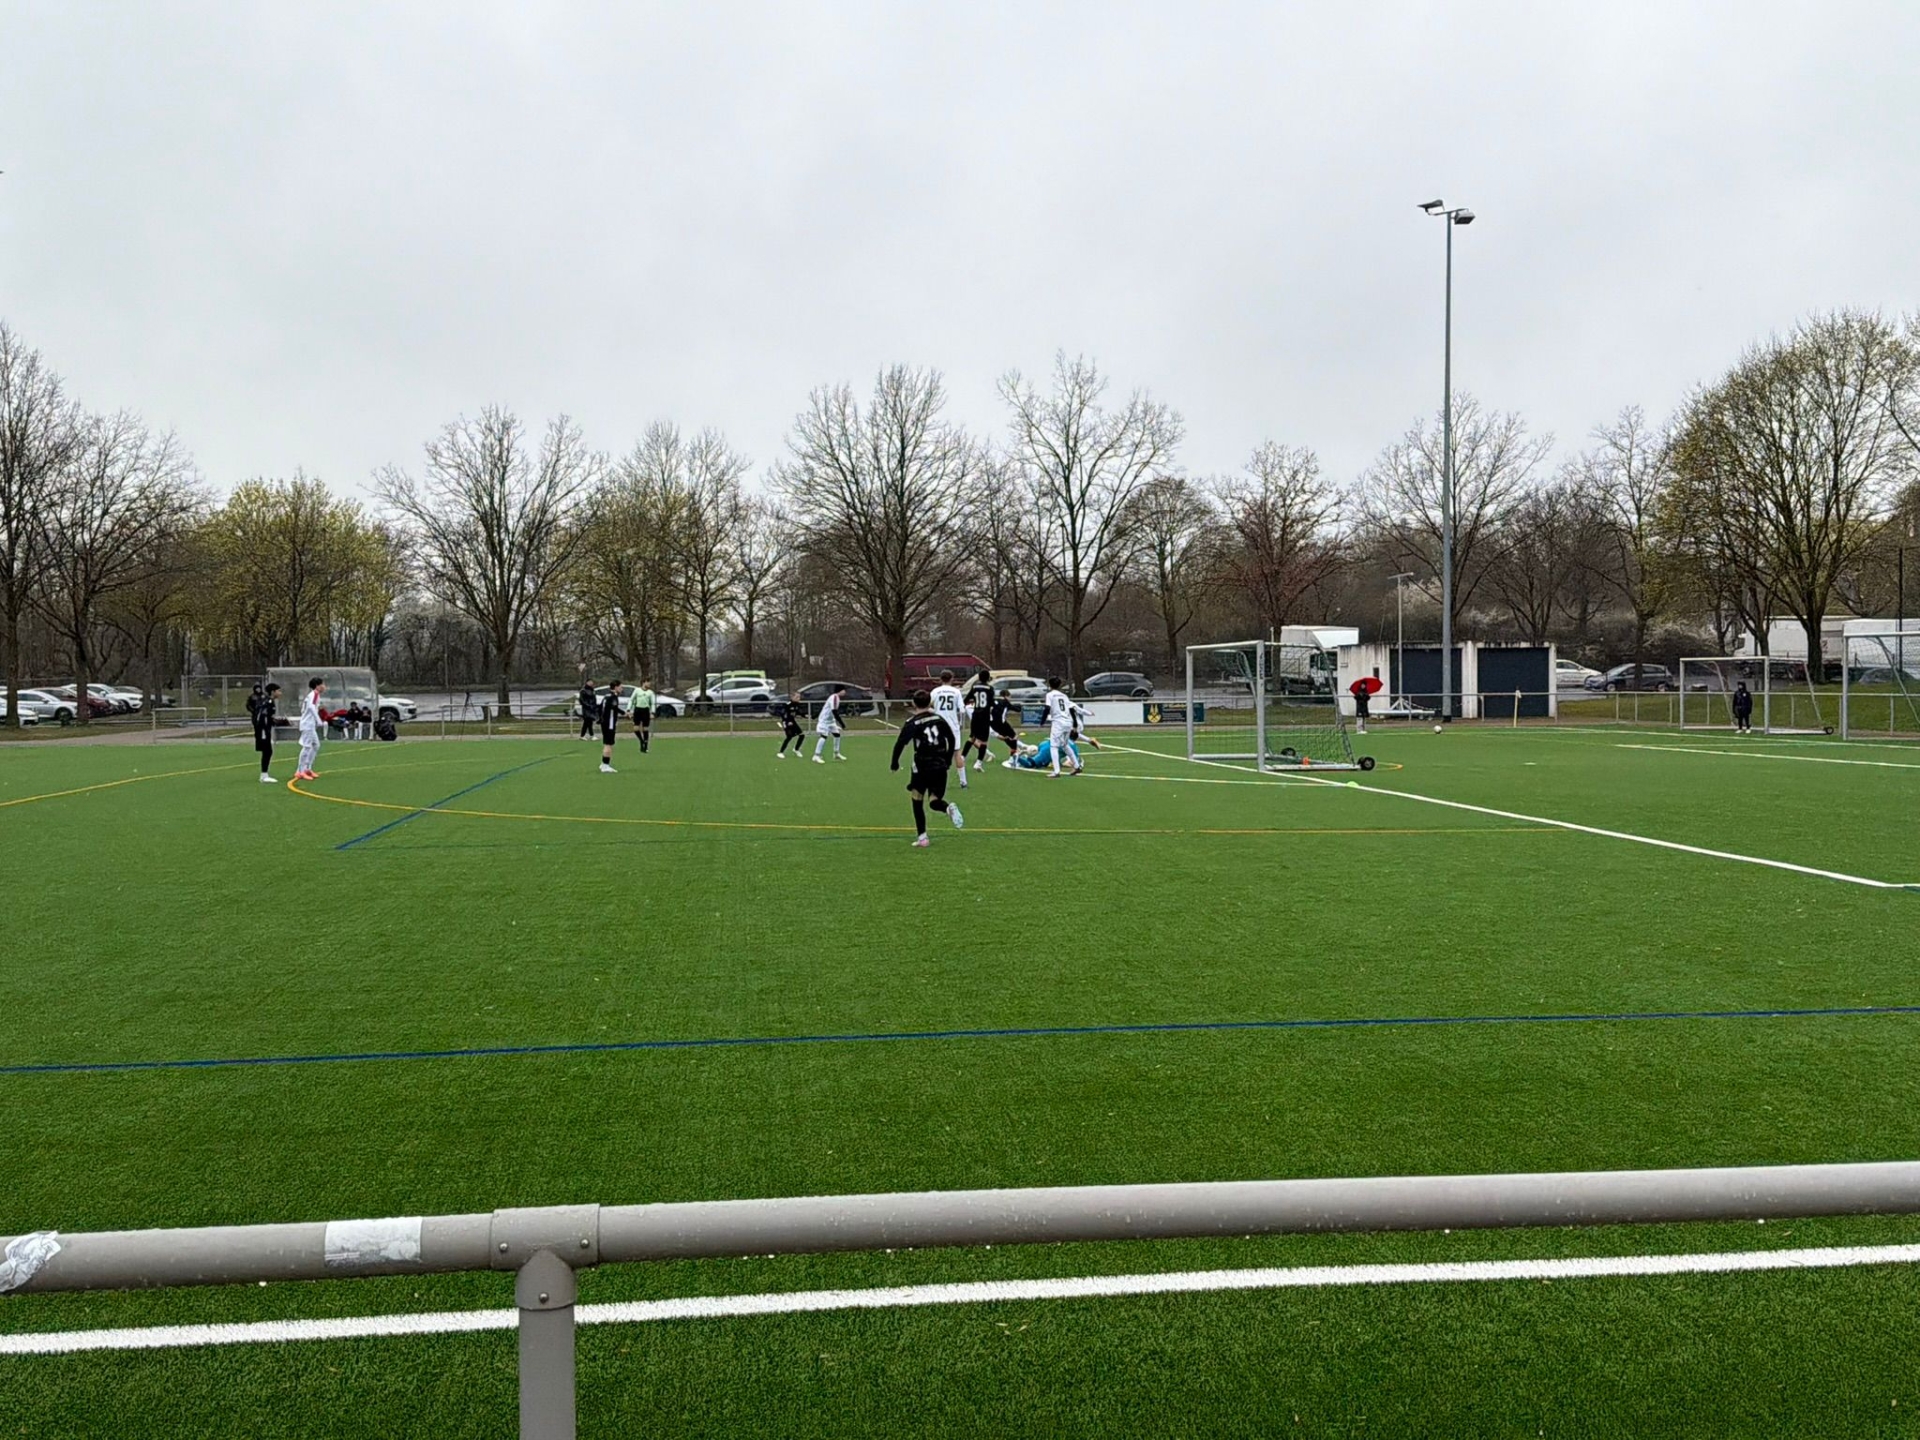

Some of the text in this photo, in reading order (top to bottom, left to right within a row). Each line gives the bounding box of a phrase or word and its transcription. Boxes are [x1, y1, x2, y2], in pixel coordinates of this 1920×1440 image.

[939, 696, 954, 711] 25
[974, 691, 988, 708] 18
[1058, 698, 1066, 711] 6
